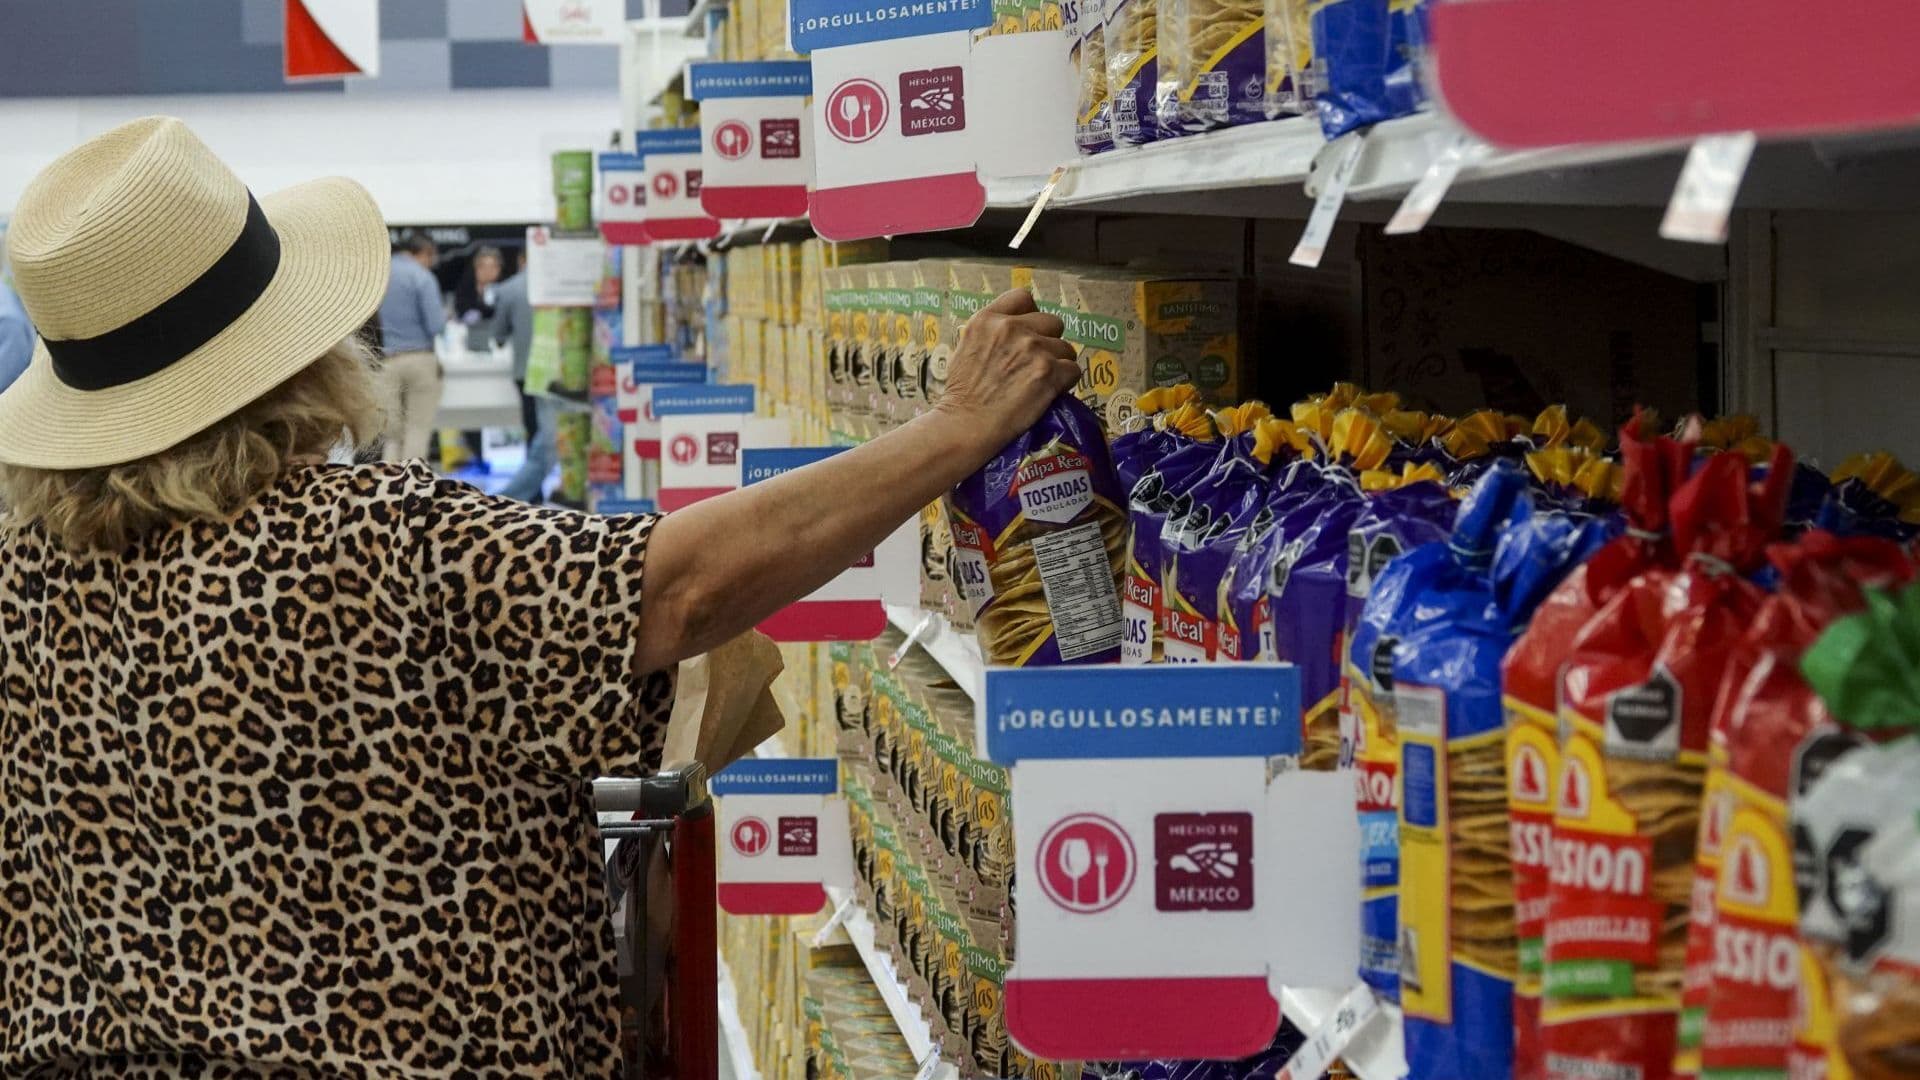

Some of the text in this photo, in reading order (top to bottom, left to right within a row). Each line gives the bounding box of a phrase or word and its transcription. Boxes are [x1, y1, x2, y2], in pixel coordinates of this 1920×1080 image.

[800, 0, 977, 33] ¡ORGULLOSAMENTE!
[908, 75, 954, 87] HECHO EN
[1017, 462, 1054, 487] Milpa
[1024, 476, 1088, 508] TOSTADAS
[1031, 495, 1088, 516] ONDULADAS
[1127, 576, 1153, 606] Real
[1172, 611, 1203, 643] Real
[999, 706, 1279, 732] ¡ORGULLOSAMENTE!
[715, 773, 829, 785] ¡ORGULLOSAMENTE!
[1168, 824, 1238, 836] HECHO EN
